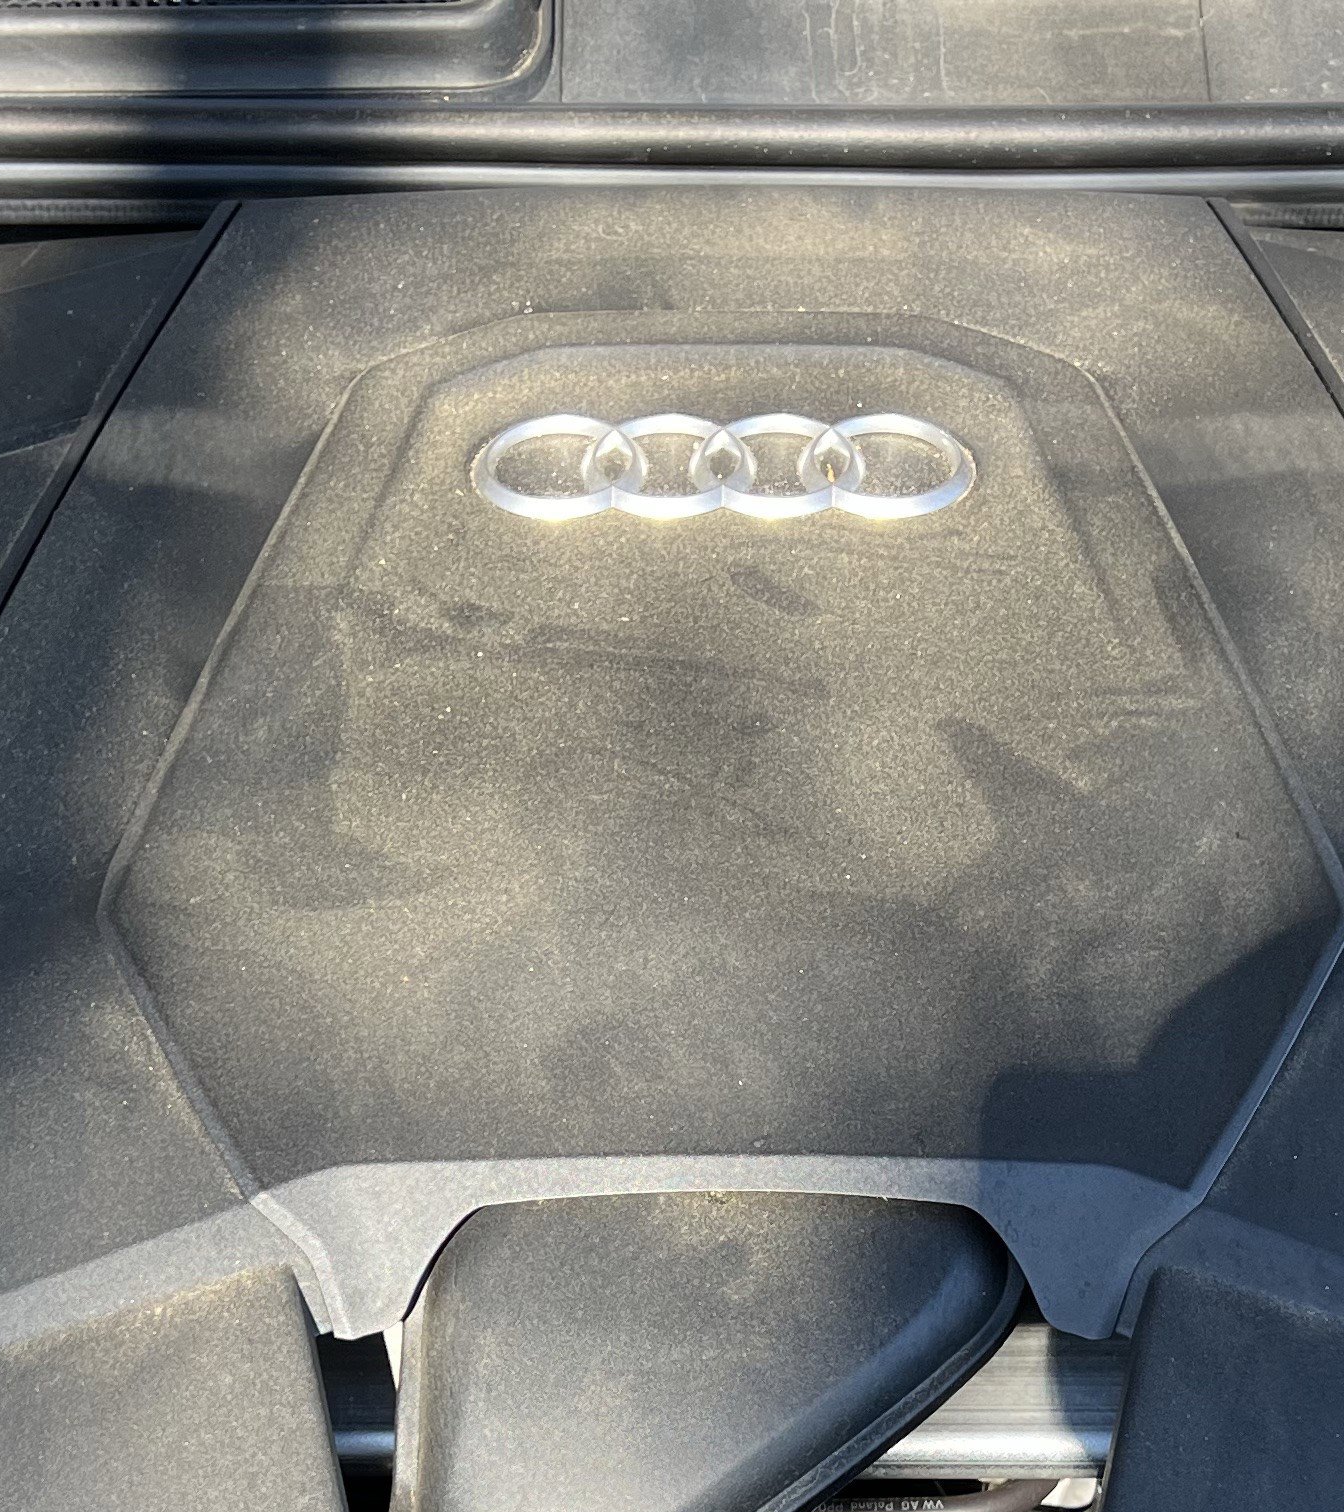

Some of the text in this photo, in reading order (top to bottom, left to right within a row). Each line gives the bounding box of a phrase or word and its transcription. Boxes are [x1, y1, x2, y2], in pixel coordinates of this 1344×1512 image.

[850, 1500, 894, 1512] Poland
[901, 1499, 919, 1511] AG
[922, 1499, 945, 1510] VW
